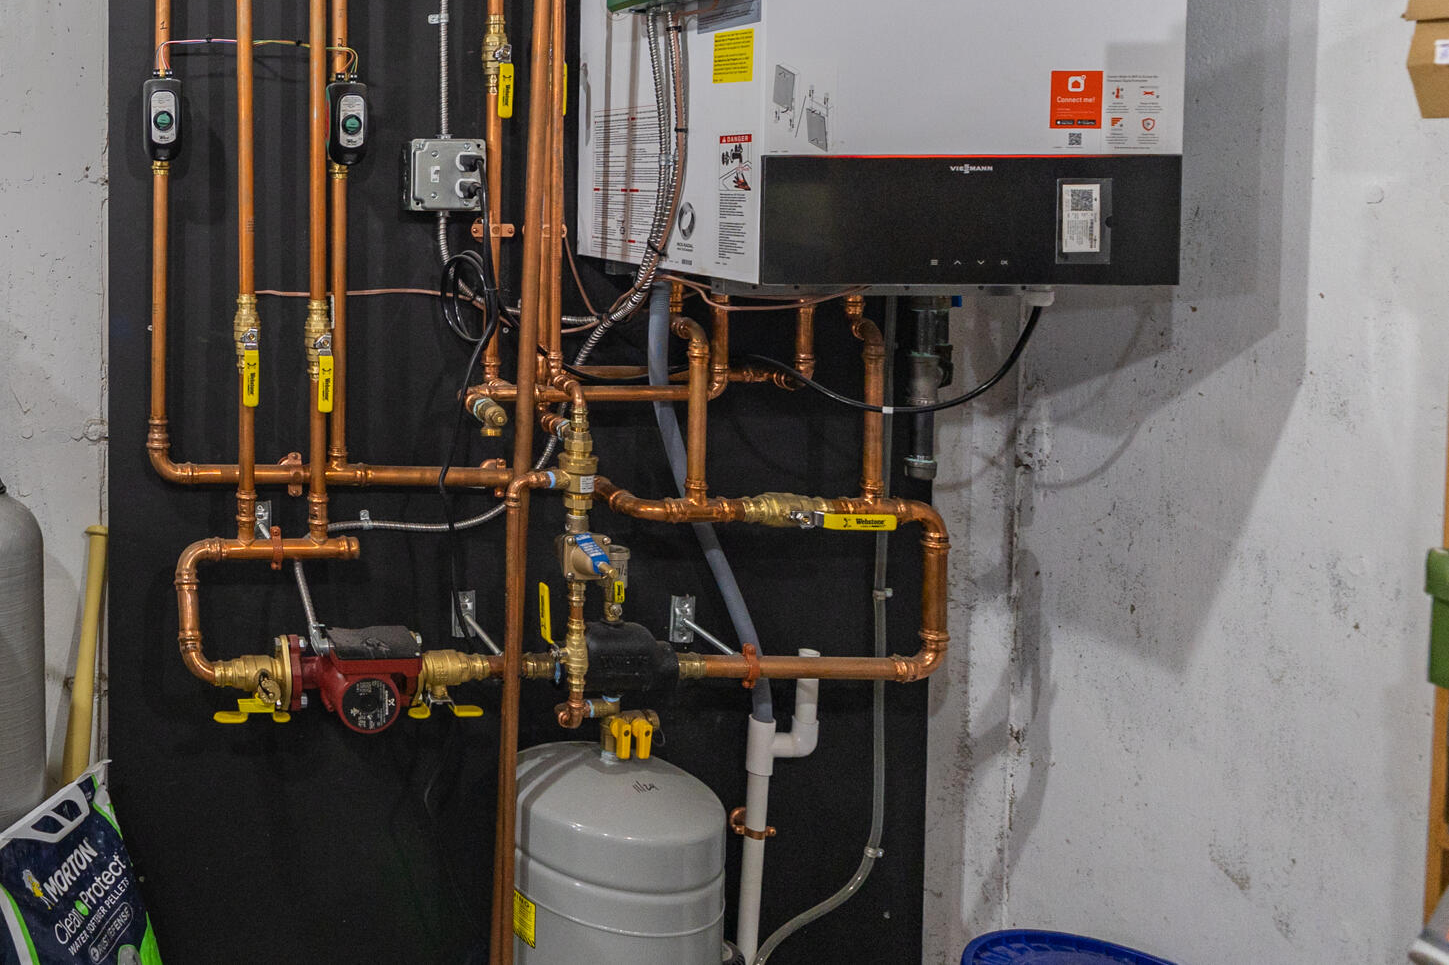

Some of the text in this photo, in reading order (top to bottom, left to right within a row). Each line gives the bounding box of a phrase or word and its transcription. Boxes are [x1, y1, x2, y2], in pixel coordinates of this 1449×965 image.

[727, 135, 748, 143] DANGER
[43, 843, 99, 903] MORTON
[55, 853, 127, 944] Clean Protect
[68, 930, 89, 956] WATER
[104, 876, 130, 909] PELLETS
